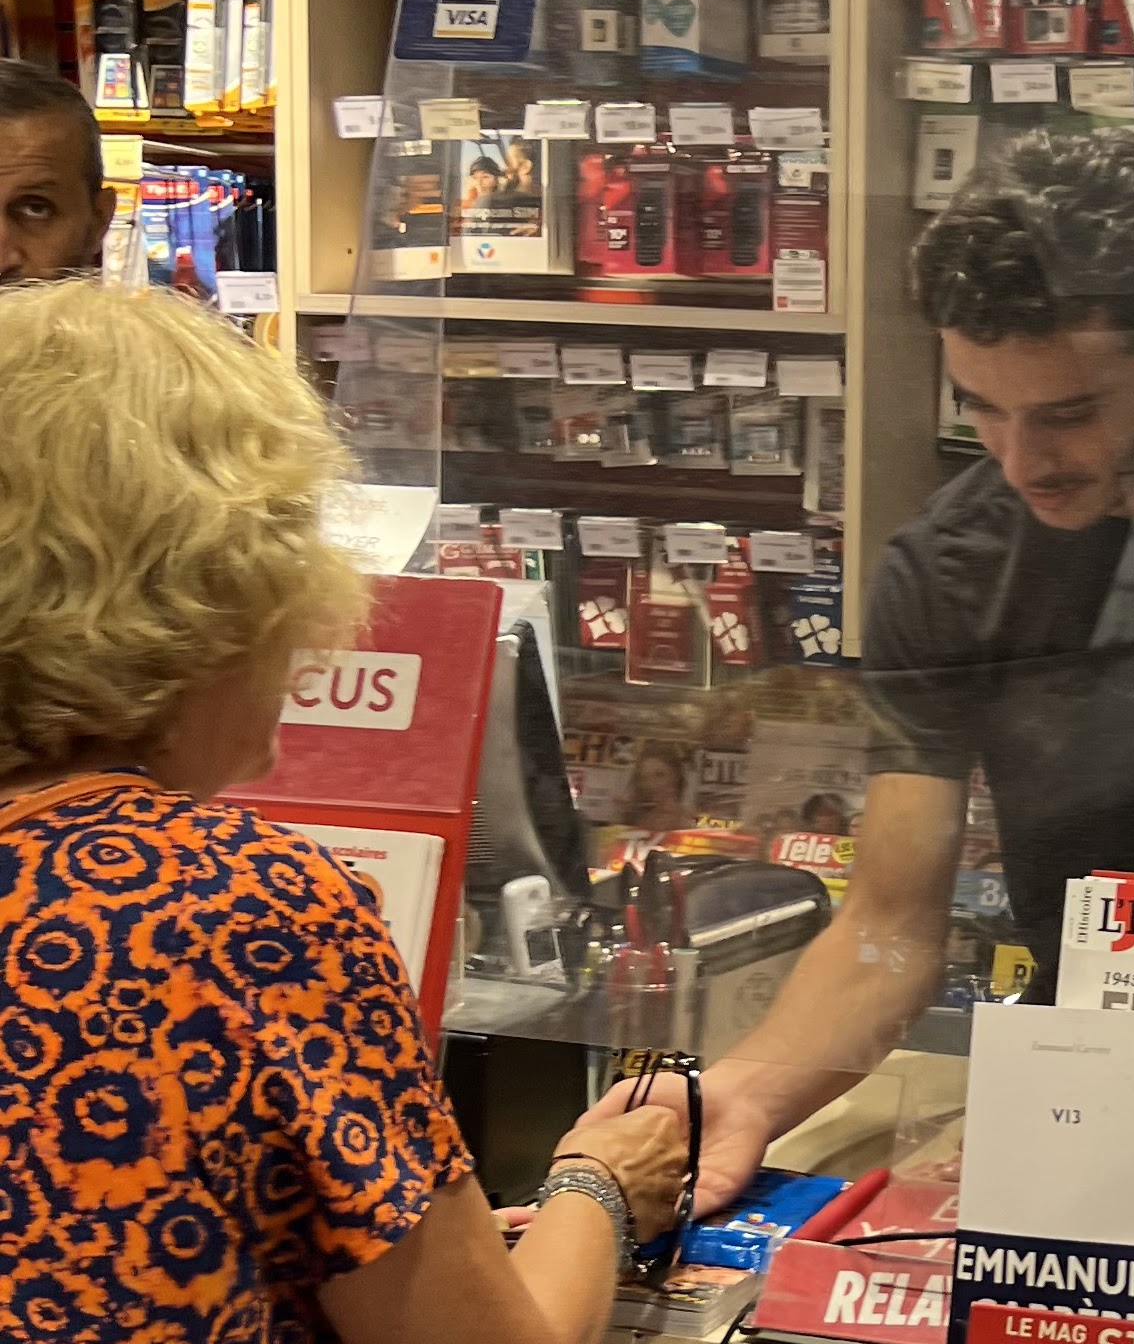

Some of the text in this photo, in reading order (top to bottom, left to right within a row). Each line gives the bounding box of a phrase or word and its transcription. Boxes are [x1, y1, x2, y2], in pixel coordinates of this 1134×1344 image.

[447, 9, 488, 26] VISA
[290, 666, 398, 712] CUS
[823, 1269, 953, 1327] RELA
[1005, 1316, 1034, 1339] LE
[1038, 1320, 1087, 1344] MAG
